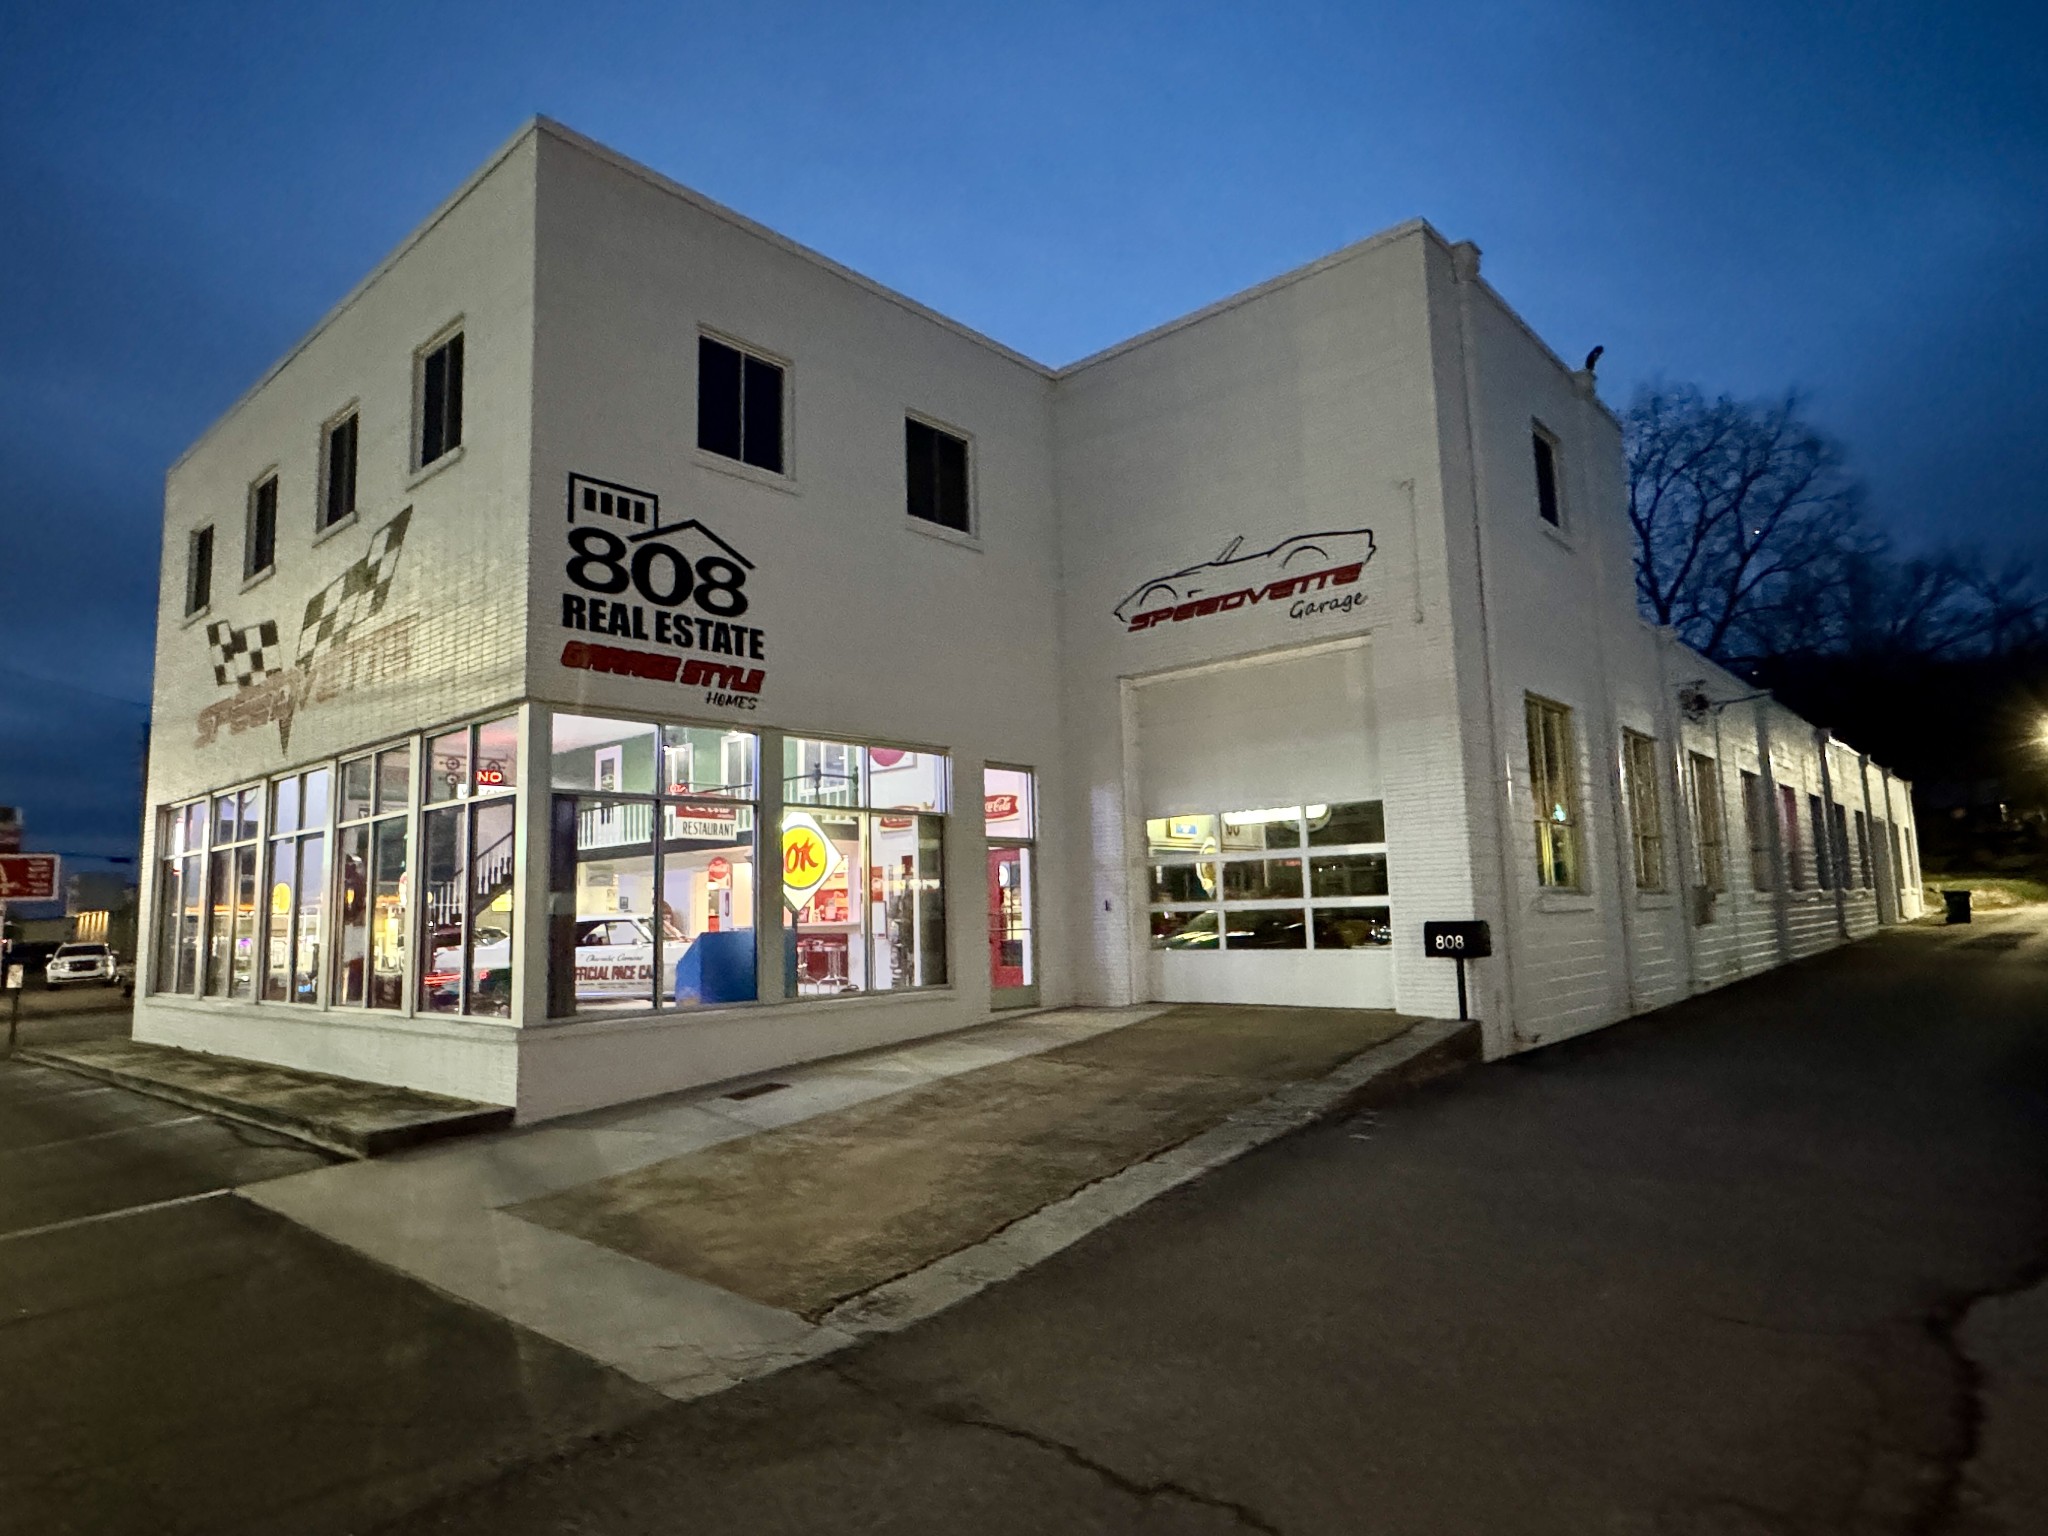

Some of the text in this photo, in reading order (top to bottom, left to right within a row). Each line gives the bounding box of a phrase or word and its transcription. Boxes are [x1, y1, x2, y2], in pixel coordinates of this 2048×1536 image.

[566, 526, 748, 617] 808
[1289, 592, 1367, 619] Garage
[562, 593, 765, 660] REAL ESTATE
[680, 659, 765, 694] STYLE
[706, 691, 757, 710] HOMES
[477, 771, 502, 783] NO
[682, 821, 734, 836] RESTAURANT
[785, 837, 818, 873] OK
[1435, 934, 1464, 949] 808
[574, 964, 654, 980] FFICIAL PACE CA
